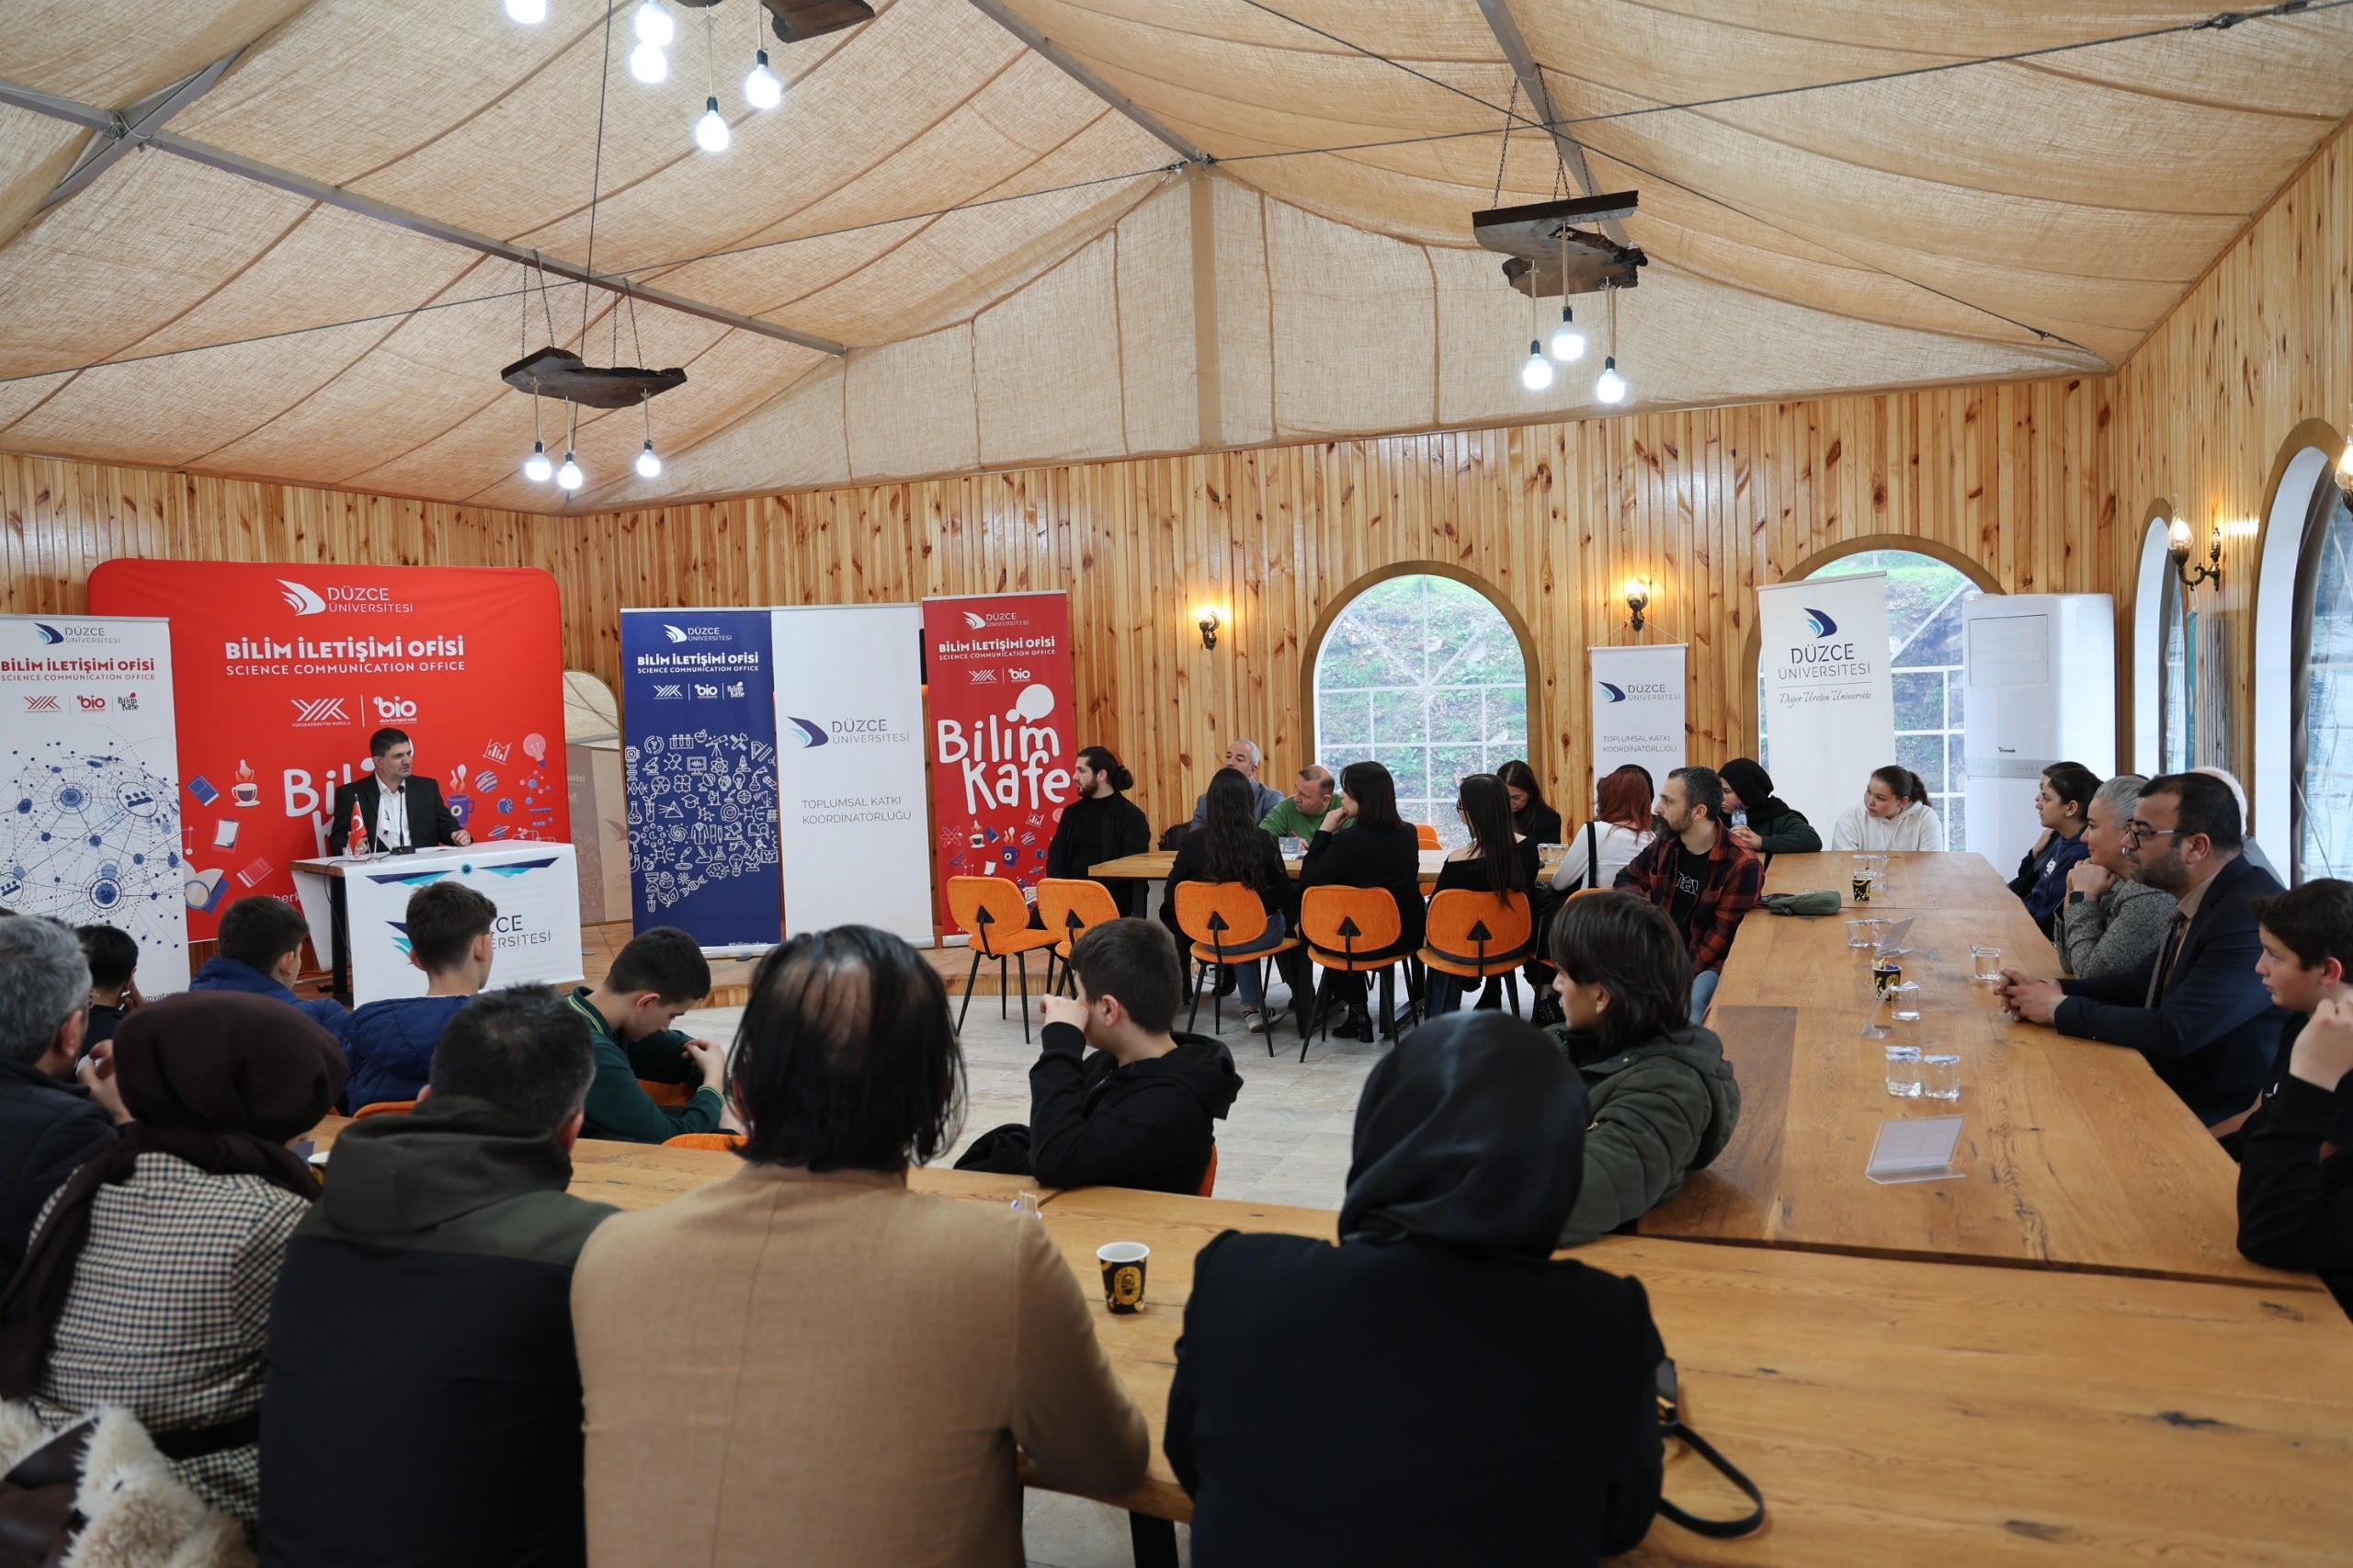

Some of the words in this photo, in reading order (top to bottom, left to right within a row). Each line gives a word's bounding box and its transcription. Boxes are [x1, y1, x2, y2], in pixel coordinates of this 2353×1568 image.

[327, 585, 390, 601] DÜZCE
[328, 602, 413, 613] ÜNİVERSİTESİ
[986, 612, 1017, 621] DÜZCE
[64, 626, 105, 636] DÜZCE
[688, 627, 720, 635] DÜZCE
[225, 636, 291, 660] BİLİM
[298, 635, 402, 662] İLETİŞİMİ
[407, 634, 464, 657] OFİSİ
[938, 641, 970, 653] BİLİM
[972, 637, 1023, 652] İLETİŞİMİ
[1025, 635, 1055, 648] OFİSİ
[637, 653, 670, 665] BİLİM
[672, 652, 725, 666] İLETİŞİMİ
[727, 652, 759, 665] OFİSİ
[970, 651, 1029, 659] COMMUNICATION
[1790, 643, 1855, 664] DÜZCE
[1, 657, 43, 671] BİLİM
[47, 657, 114, 674] İLETİŞİMİ
[118, 657, 154, 671] OFİSİ
[226, 664, 289, 676] SCIENCE
[294, 663, 415, 675] COMMUNICATION
[419, 661, 465, 672] OFFICE
[1008, 667, 1031, 679] bio
[1778, 661, 1870, 680] ÜNİVERSİTESİ
[694, 684, 718, 696] bio
[1628, 684, 1665, 693] DÜZCE
[77, 695, 106, 709] bio
[372, 696, 417, 719] bio
[831, 718, 888, 733] DÜZCE
[832, 733, 909, 744] ÜNİVERSİTESİ
[937, 714, 1061, 764] Bilim
[961, 750, 1071, 815] Kafe
[801, 798, 868, 809] TOPLUMSAL
[870, 796, 901, 806] KATKI
[802, 809, 912, 825] KOORDİNATÖRLÜĞÜ
[492, 929, 551, 949] ERSİTESİ
